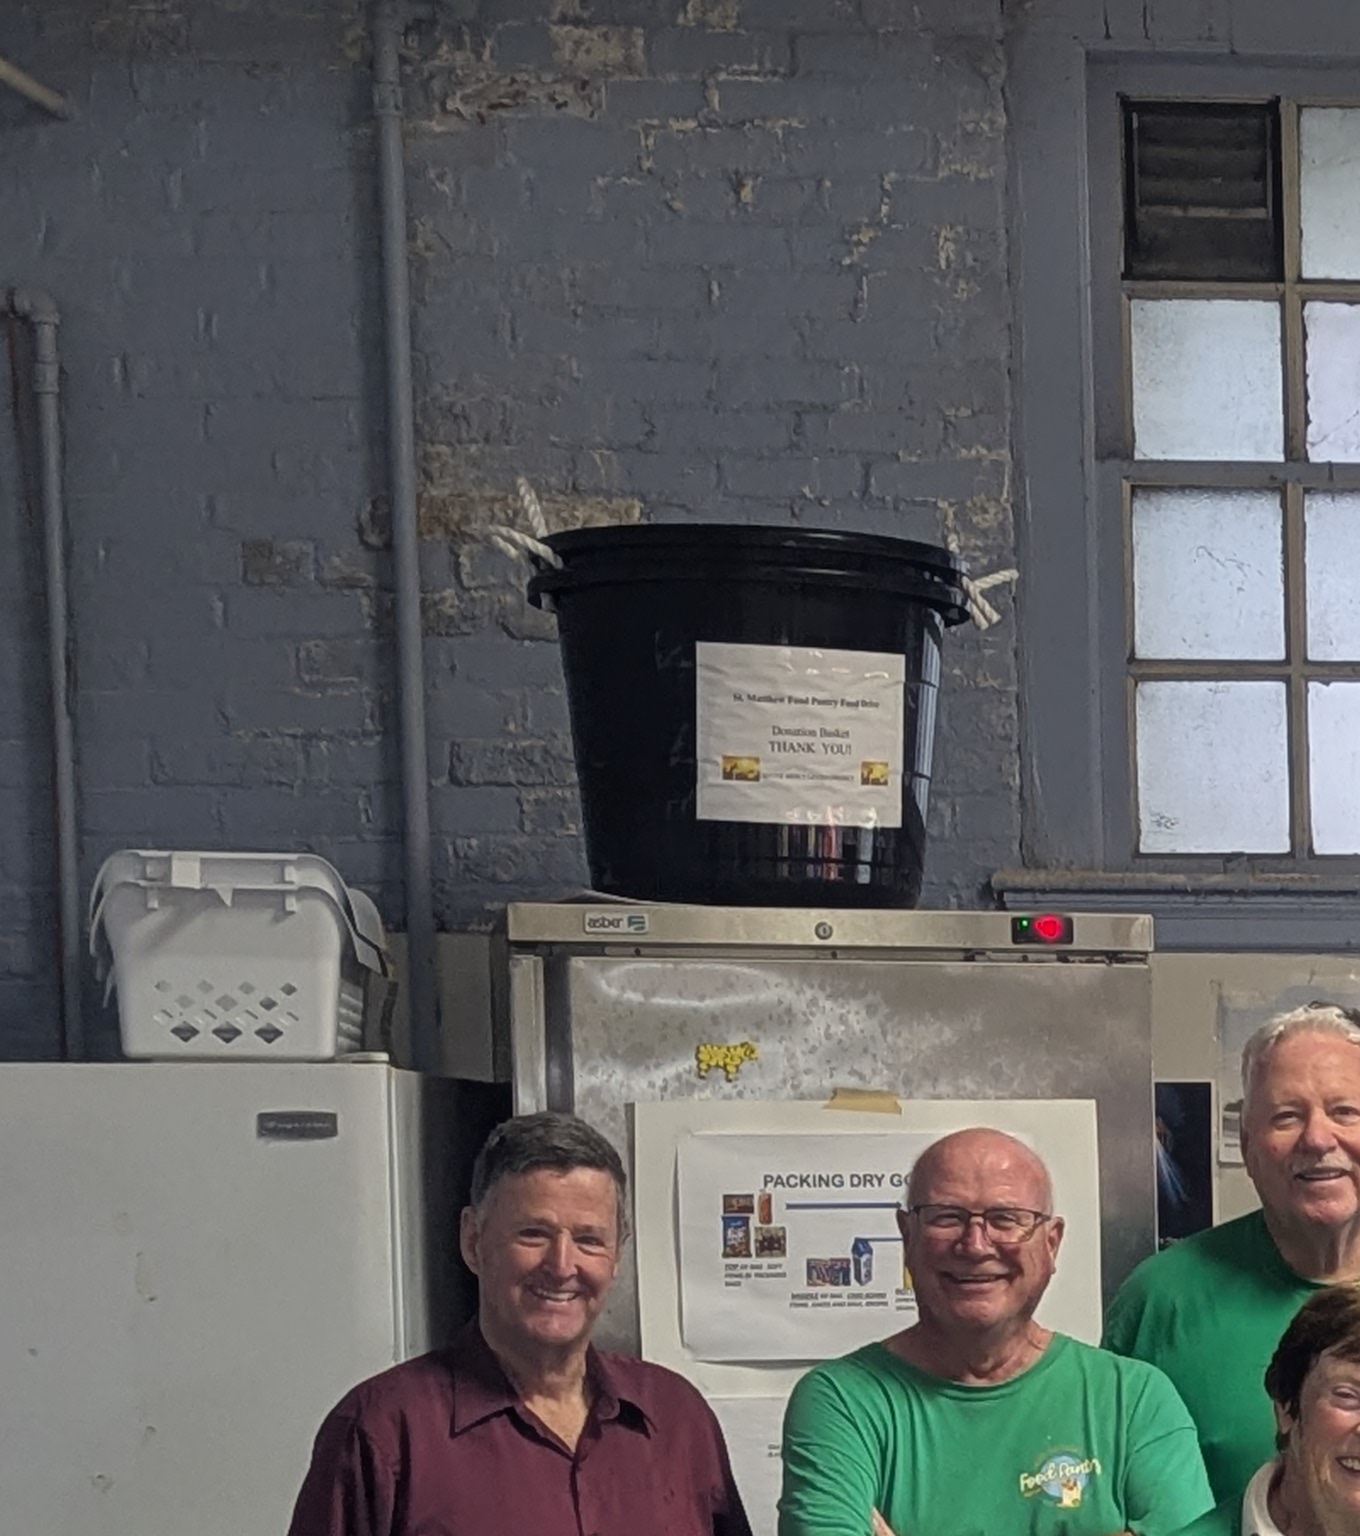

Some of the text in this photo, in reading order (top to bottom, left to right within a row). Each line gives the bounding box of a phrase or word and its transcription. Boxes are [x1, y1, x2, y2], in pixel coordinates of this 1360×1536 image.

[747, 694, 785, 704] Matthew
[788, 695, 809, 705] Food
[811, 696, 838, 708] Pantry
[840, 698, 860, 708] Food
[861, 700, 879, 709] Drive
[772, 725, 850, 739] Donation Basket
[769, 741, 852, 755] THANK YOU!
[763, 1173, 845, 1188] PACKING
[850, 1173, 885, 1188] DRY
[1020, 1462, 1057, 1492] Food
